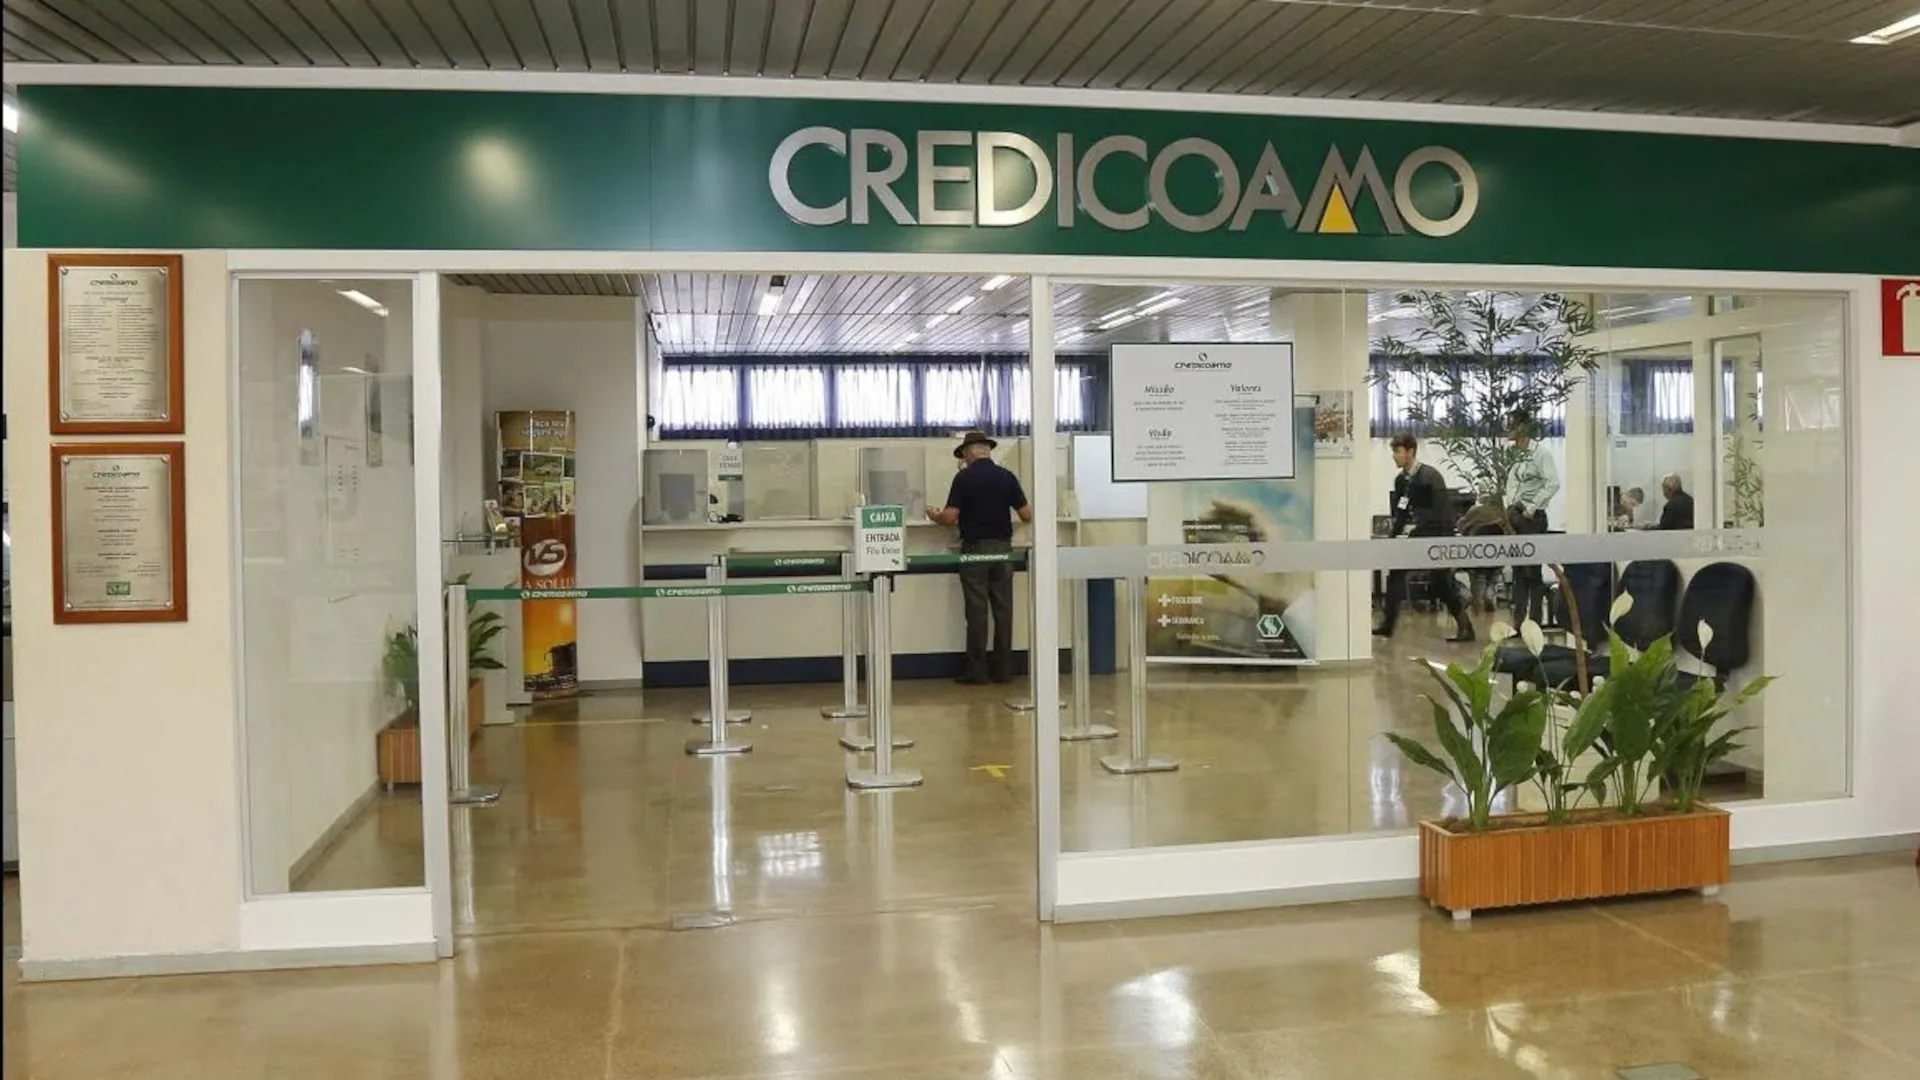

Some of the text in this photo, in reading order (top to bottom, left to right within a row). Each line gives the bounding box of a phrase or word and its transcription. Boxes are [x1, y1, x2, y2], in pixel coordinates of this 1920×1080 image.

[768, 126, 1479, 237] CREDICOAMO
[869, 511, 897, 523] CAIXA
[865, 533, 901, 543] ENTRADA
[1426, 542, 1537, 561] CREDICOAMO
